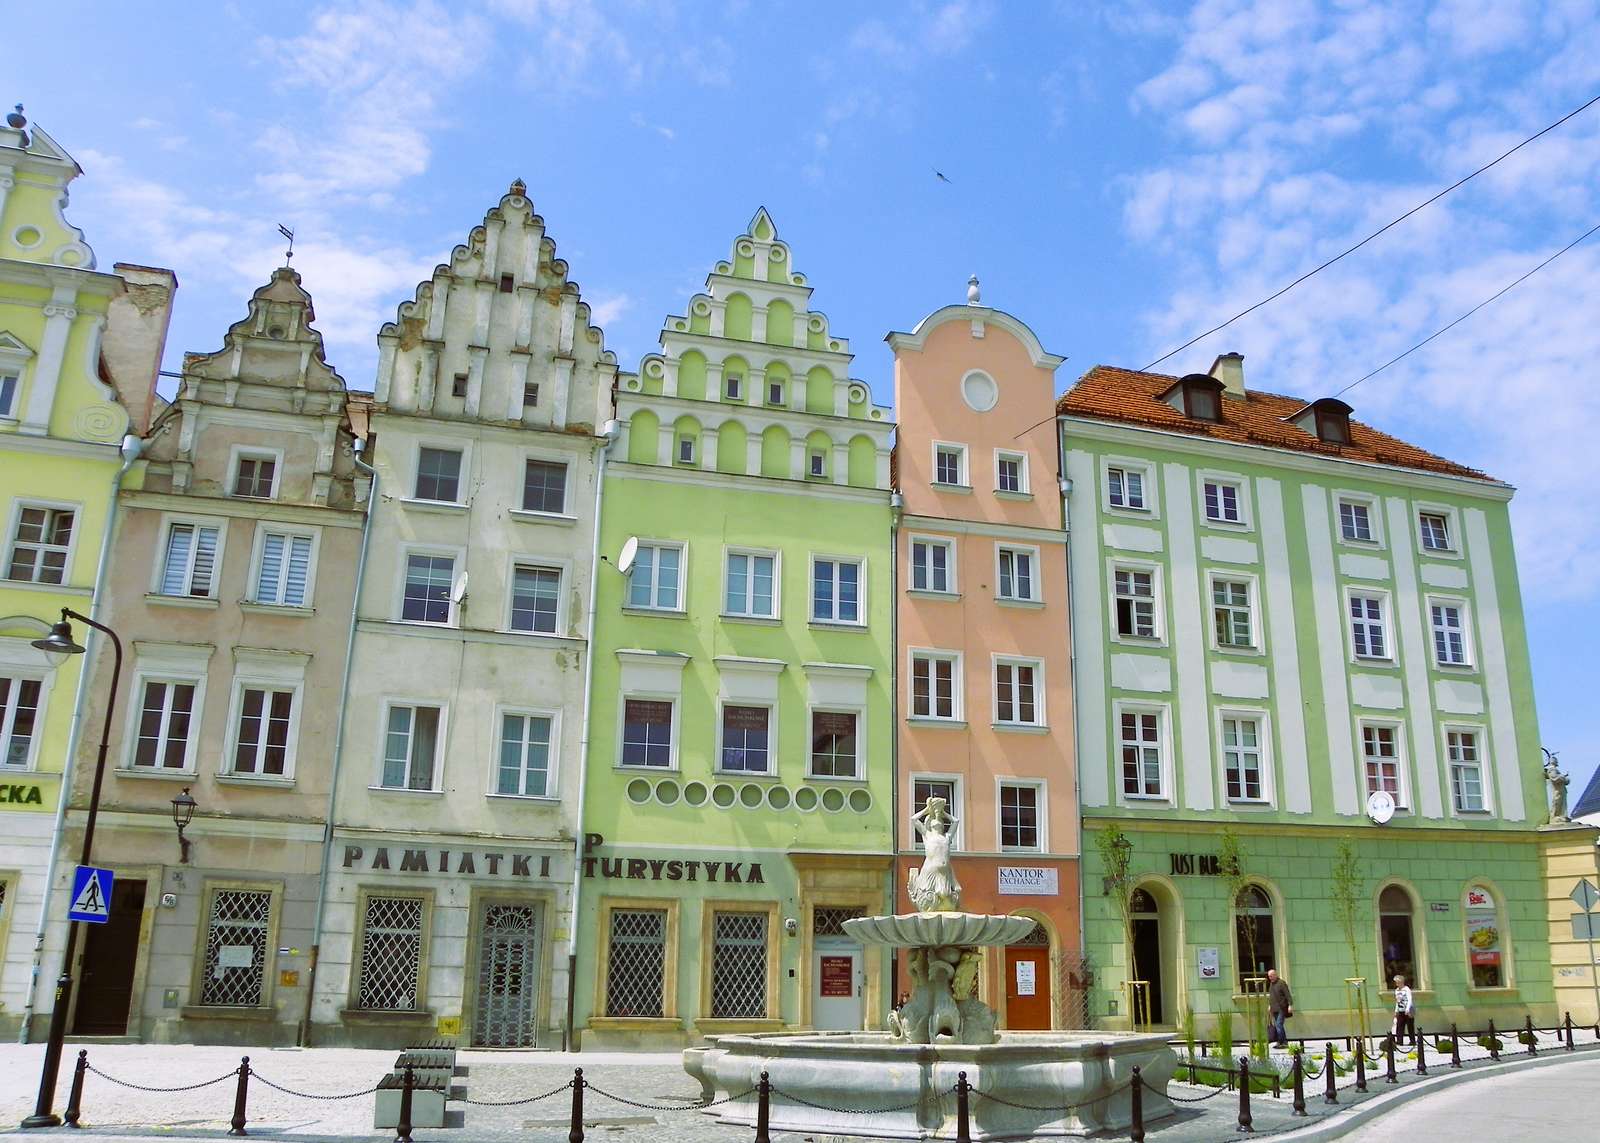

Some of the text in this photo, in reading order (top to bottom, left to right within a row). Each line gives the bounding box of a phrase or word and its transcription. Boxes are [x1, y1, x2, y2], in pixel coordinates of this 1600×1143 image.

[342, 845, 551, 877] PAMIATKI
[583, 856, 765, 884] TURYSTYKA
[1169, 853, 1195, 875] JUST
[999, 868, 1044, 878] KANTOR
[999, 877, 1041, 886] EXCHANGE
